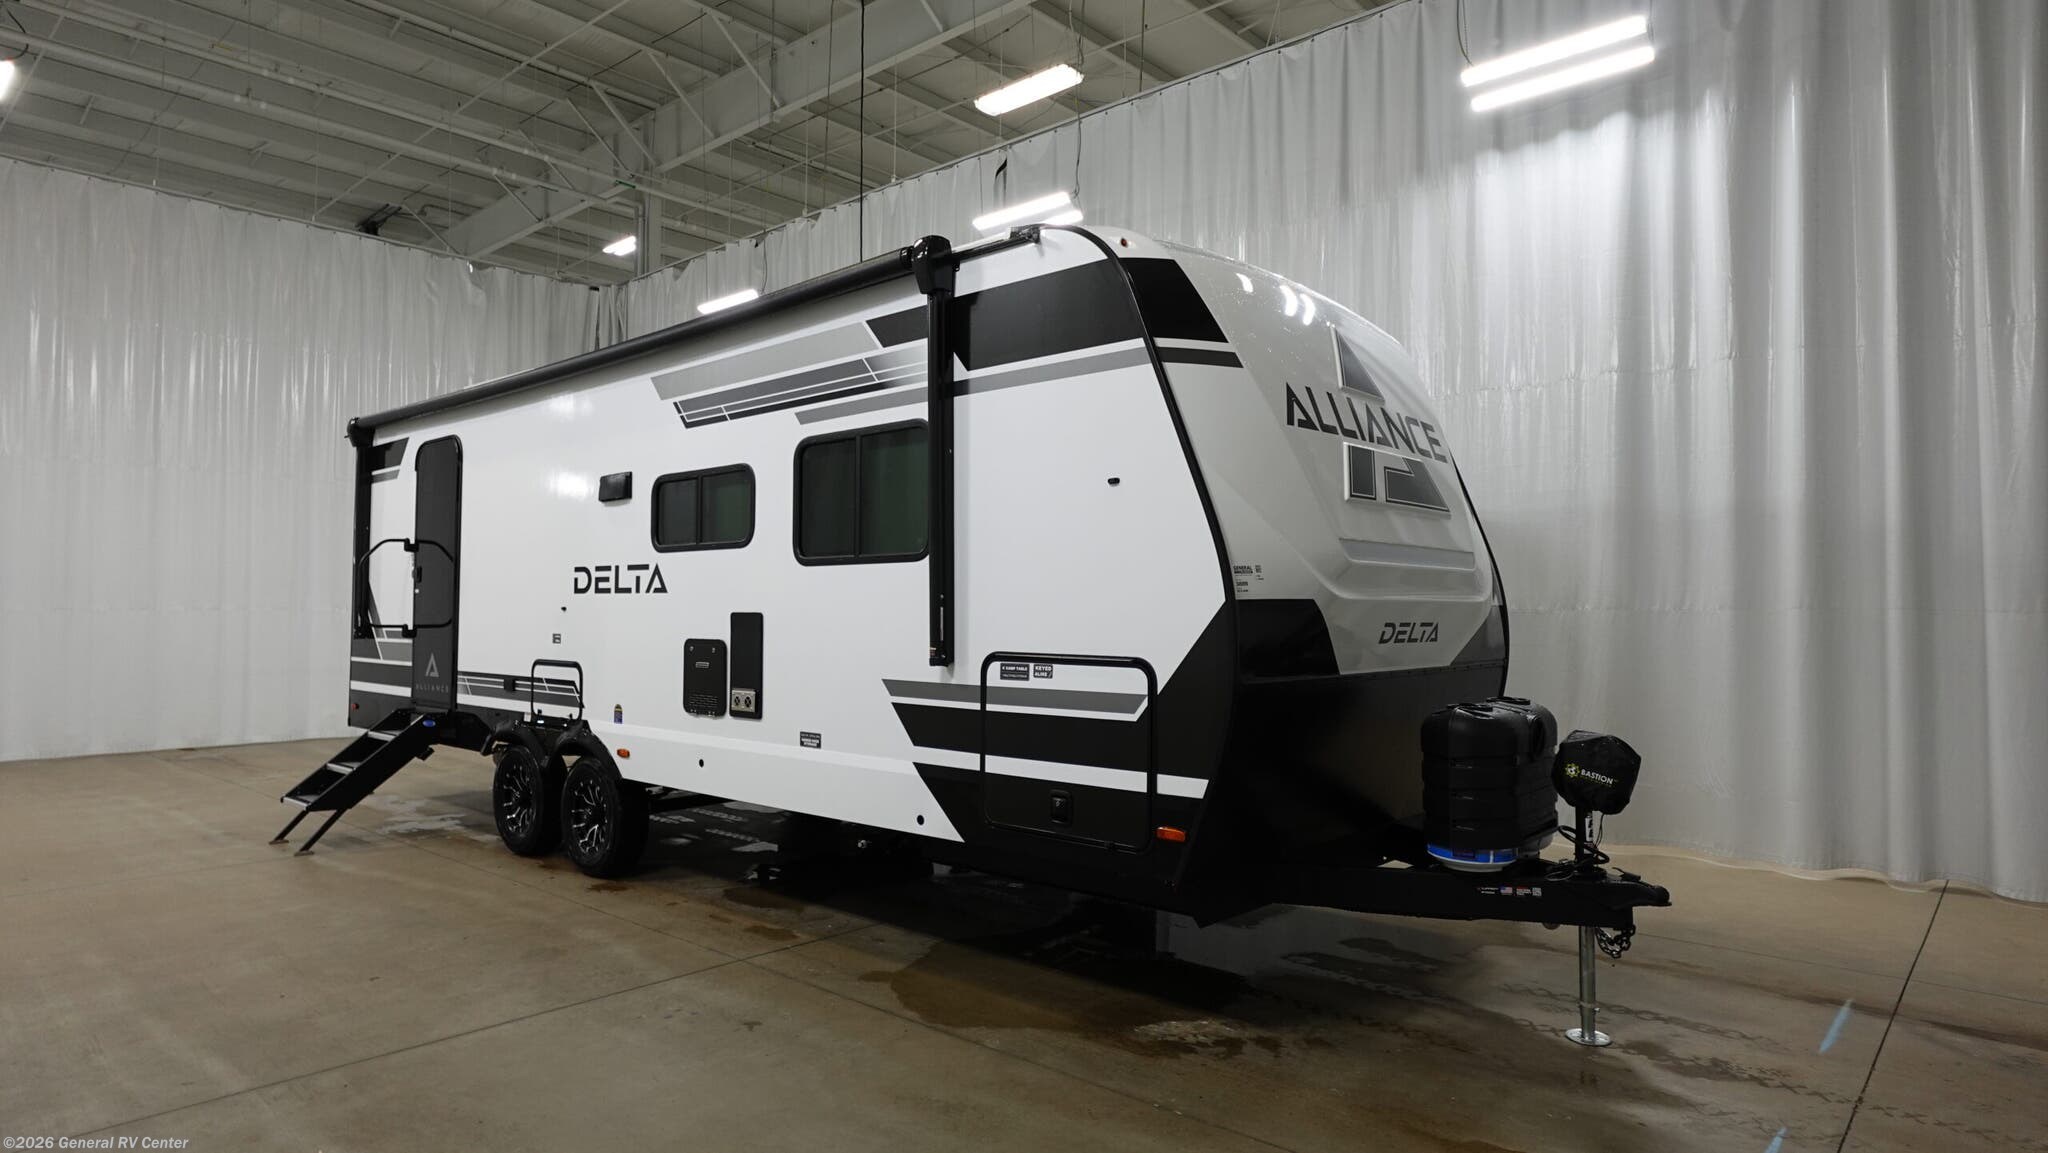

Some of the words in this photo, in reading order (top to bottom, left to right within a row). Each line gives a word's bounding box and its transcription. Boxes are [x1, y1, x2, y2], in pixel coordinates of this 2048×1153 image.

[1285, 382, 1448, 464] ALLIANCE
[573, 563, 668, 594] DELTA
[1378, 622, 1440, 644] DELTA
[1581, 768, 1614, 785] BASTION
